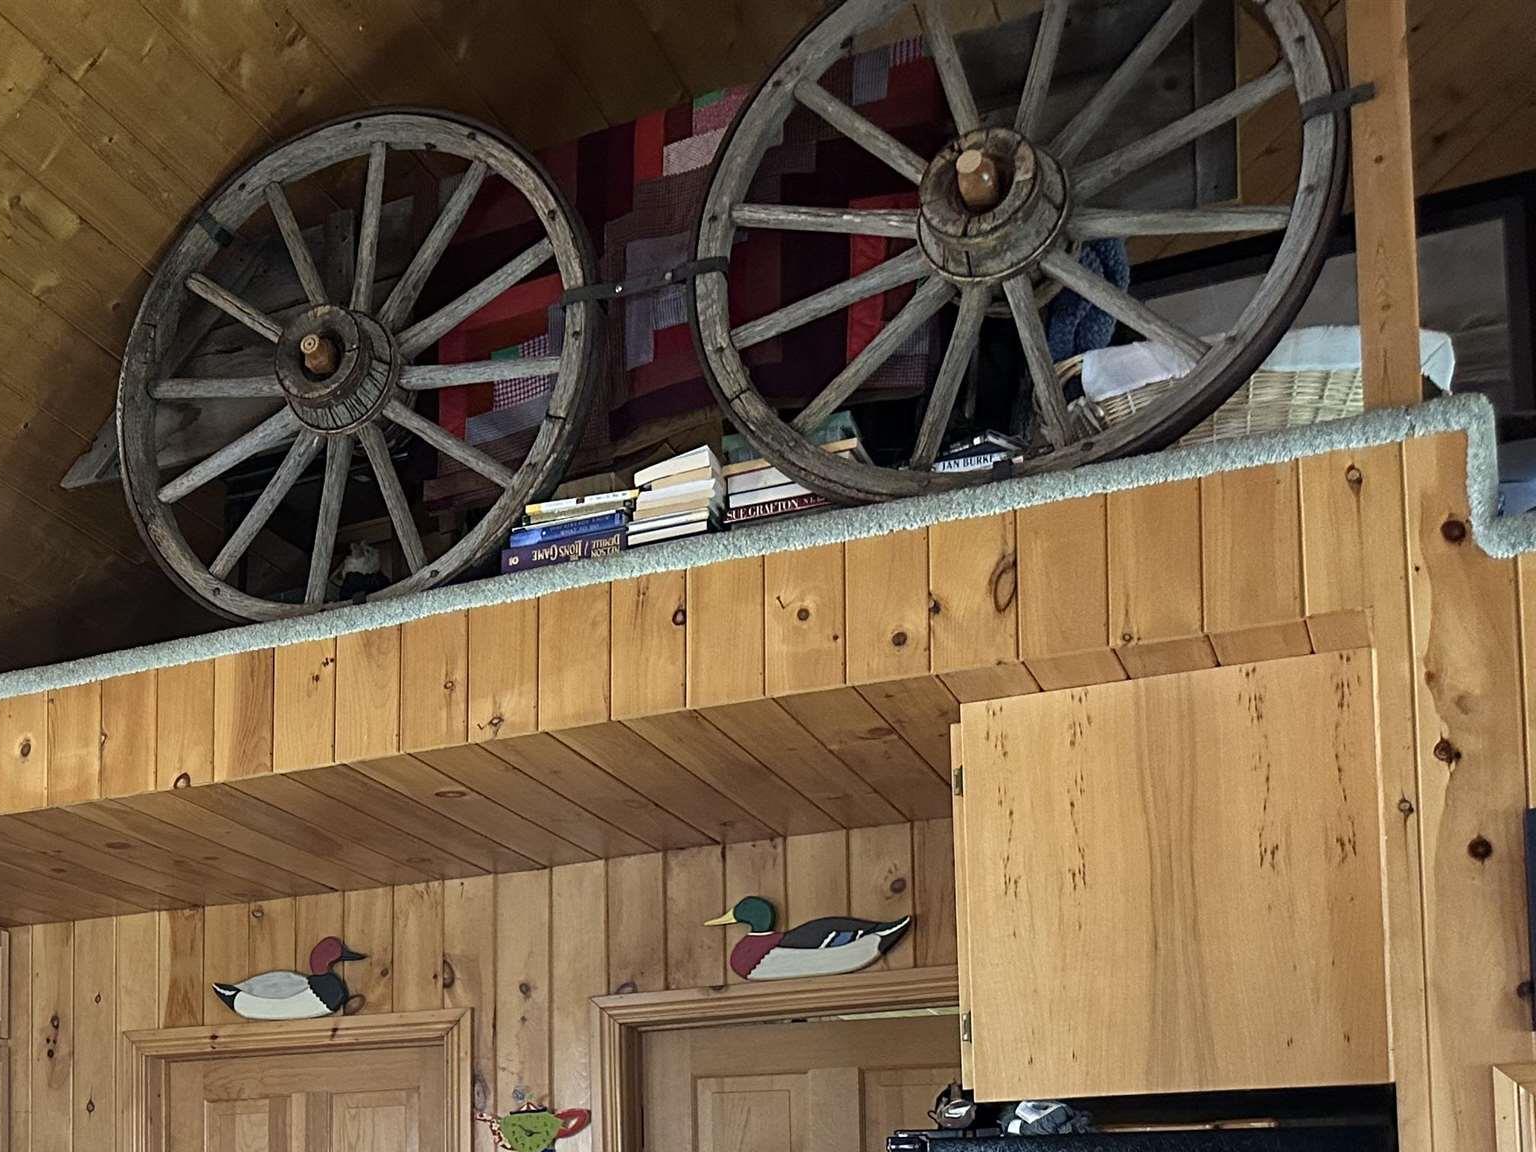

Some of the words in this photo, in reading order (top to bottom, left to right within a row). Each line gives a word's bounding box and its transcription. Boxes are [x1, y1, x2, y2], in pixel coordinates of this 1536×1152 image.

[726, 508, 747, 521] SUE
[748, 499, 799, 517] GRAFTON
[531, 544, 558, 561] GAME
